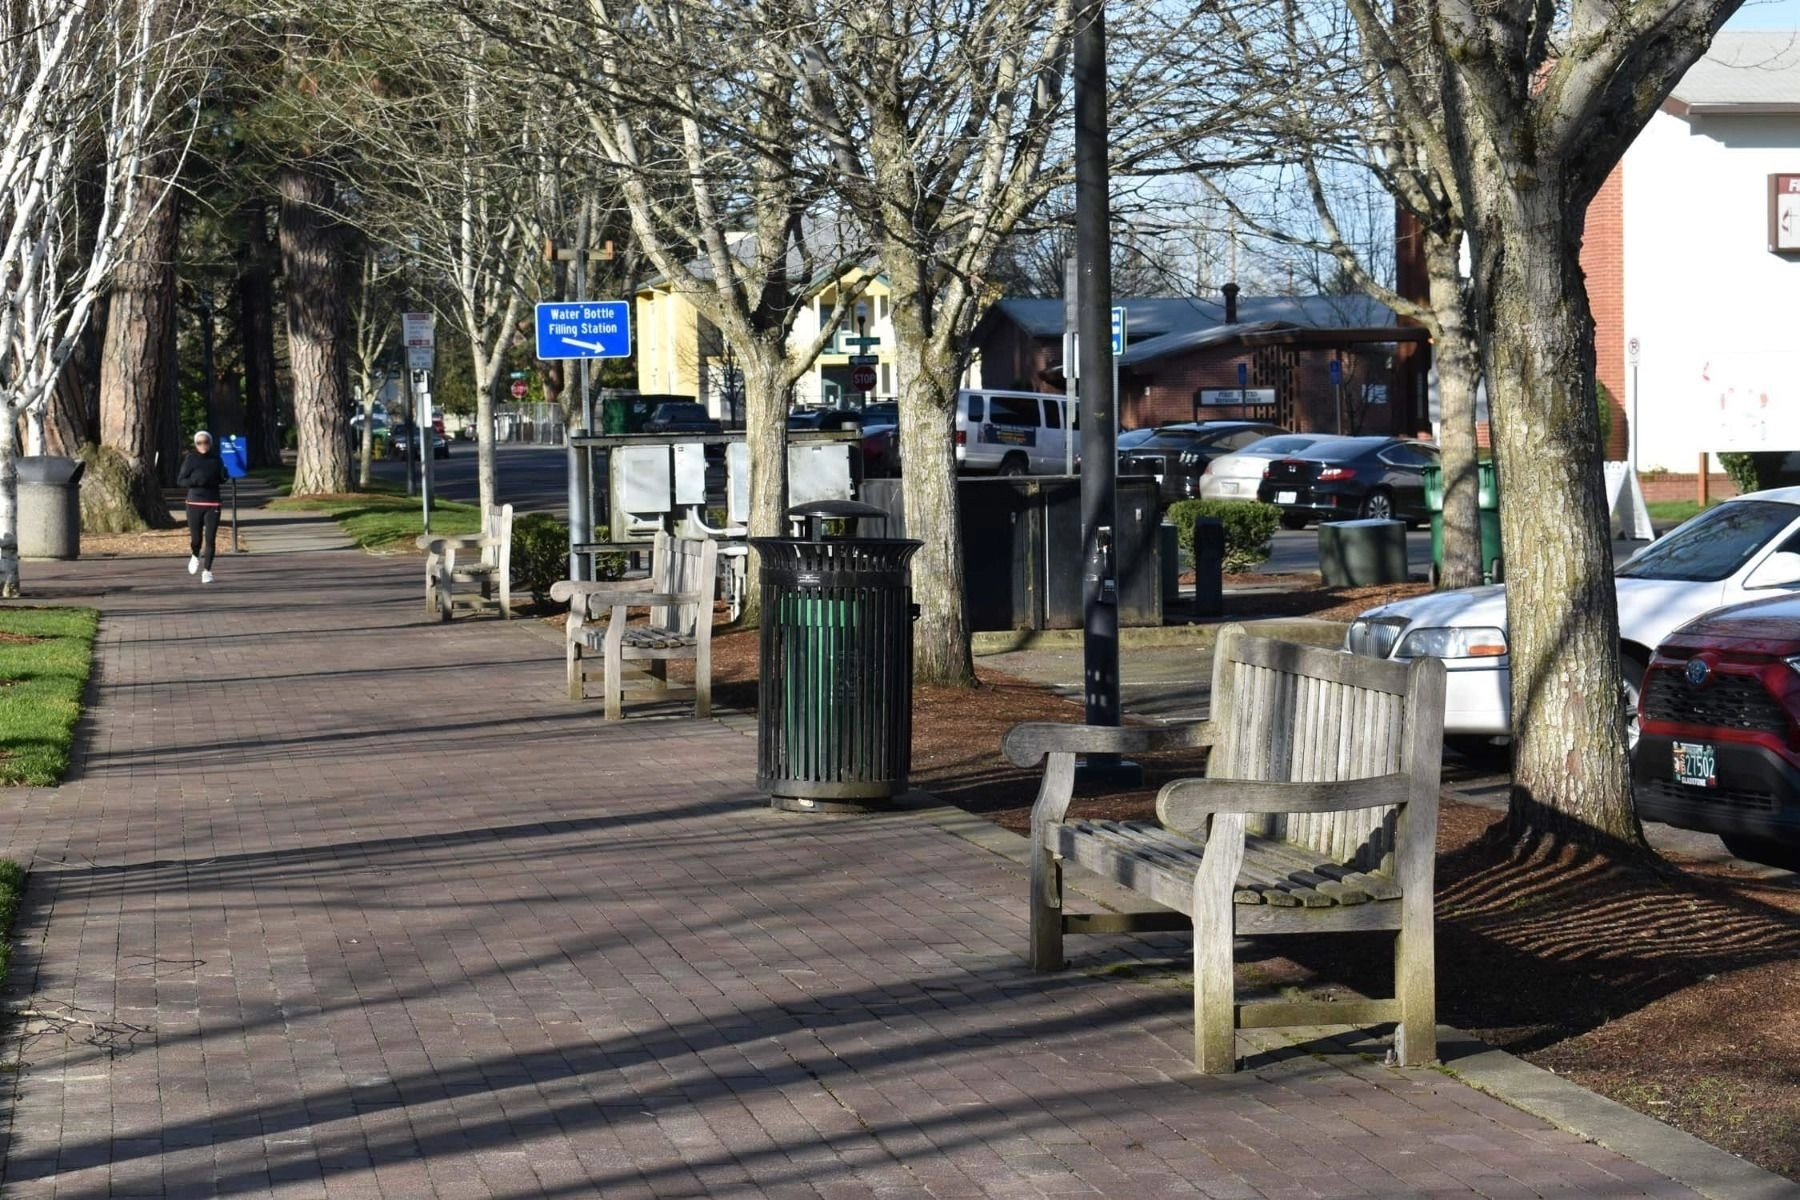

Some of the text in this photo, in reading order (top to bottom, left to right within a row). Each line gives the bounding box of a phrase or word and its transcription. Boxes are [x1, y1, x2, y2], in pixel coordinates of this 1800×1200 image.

[550, 308, 614, 320] Water Bottle
[549, 322, 617, 337] Filling Station
[855, 373, 876, 384] STOP
[1686, 755, 1715, 777] 27502
